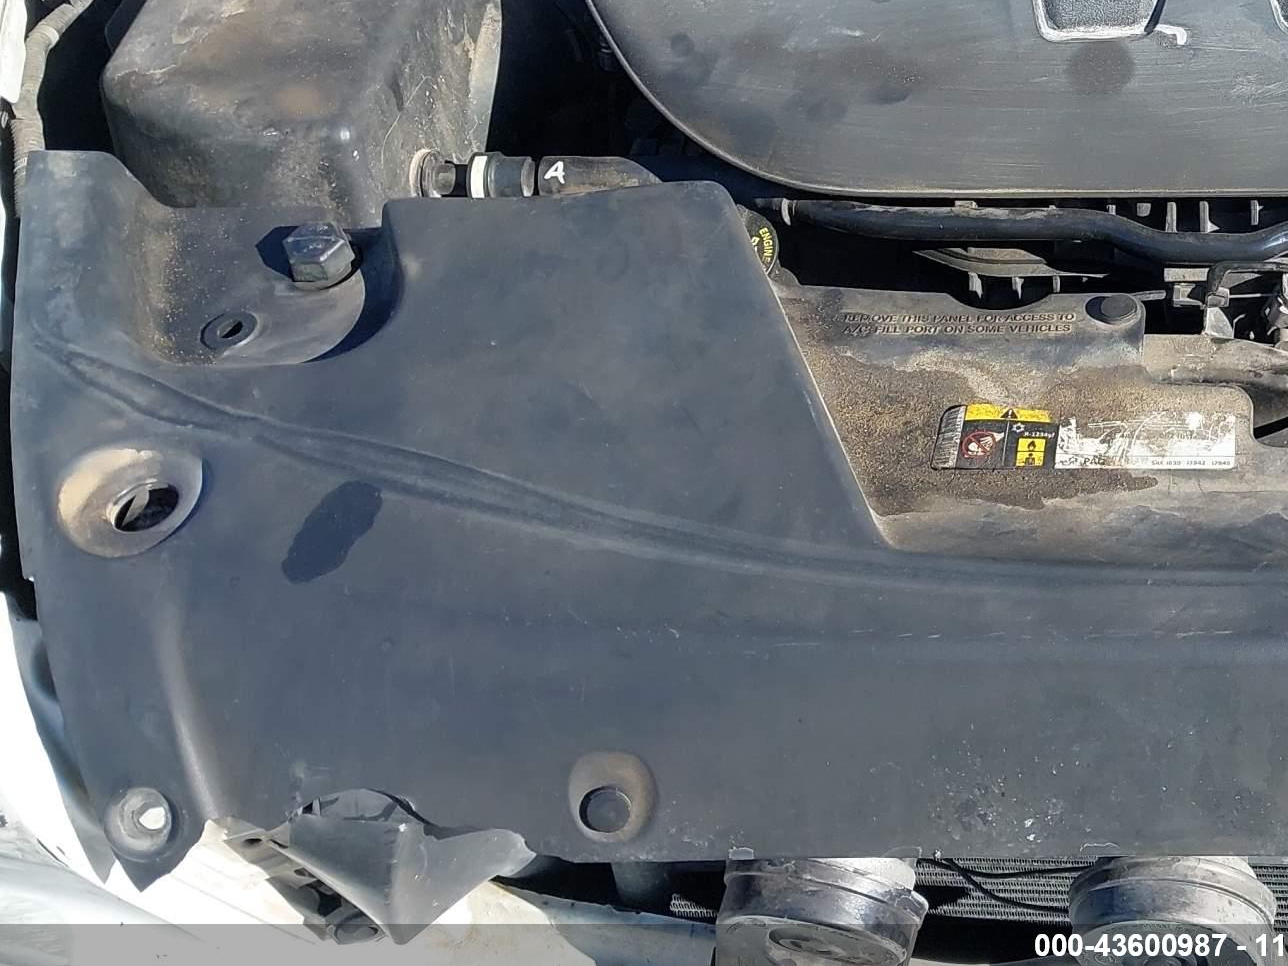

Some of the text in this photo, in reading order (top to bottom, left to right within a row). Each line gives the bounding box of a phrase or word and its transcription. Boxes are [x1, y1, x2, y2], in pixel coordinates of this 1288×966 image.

[543, 160, 566, 185] A
[843, 312, 1076, 324] REMOVE THIS PANEL FOR ACCESS TO
[874, 324, 900, 335] FILL
[904, 324, 940, 335] PORT
[943, 324, 965, 335] ON
[967, 324, 1005, 334] SOME
[1009, 323, 1073, 334] VEHICLES
